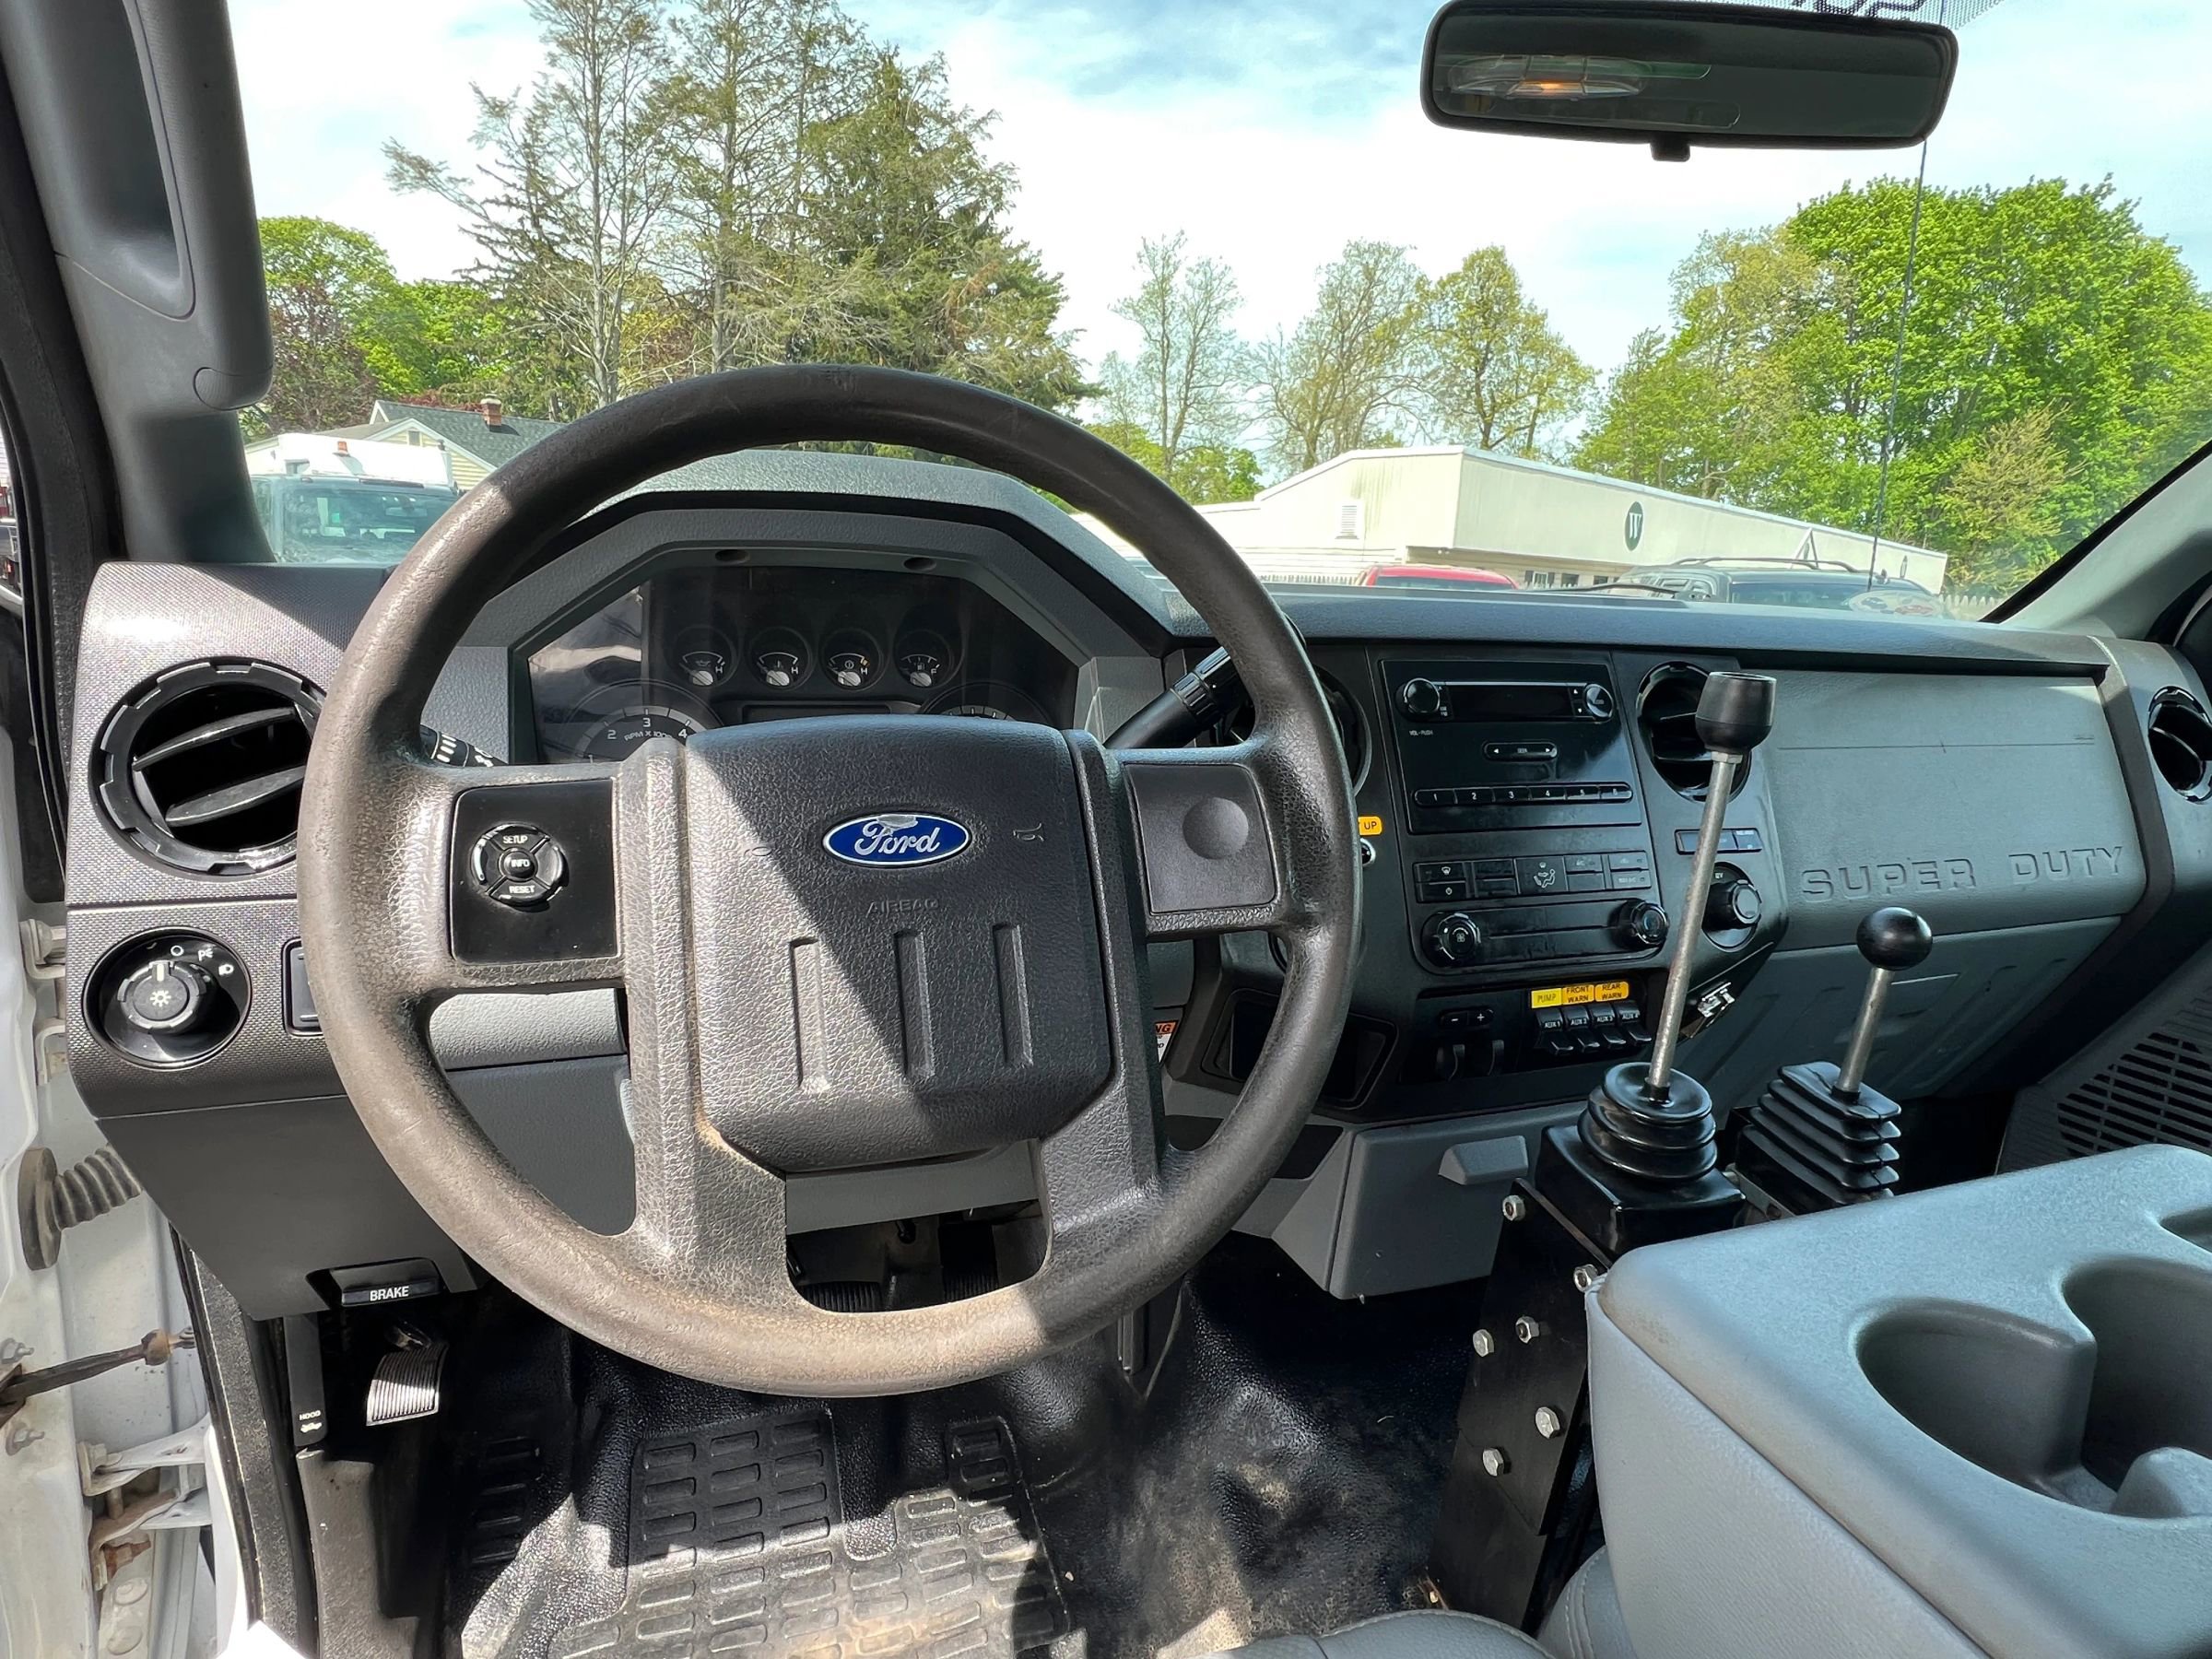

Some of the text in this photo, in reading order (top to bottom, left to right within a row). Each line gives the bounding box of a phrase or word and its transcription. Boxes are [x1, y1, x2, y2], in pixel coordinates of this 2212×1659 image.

[1629, 512, 1642, 539] W
[791, 666, 798, 675] H
[642, 717, 651, 727] 3
[607, 729, 617, 739] 2
[624, 731, 643, 741] RPM
[678, 728, 688, 738] 4
[1364, 820, 1378, 830] UP
[502, 834, 528, 844] SETUP
[853, 819, 941, 856] Ford
[511, 858, 531, 868] INFO
[1801, 845, 2124, 903] SUPER DUTY
[509, 885, 535, 894] RESET
[1567, 986, 1589, 994] FRONT
[1536, 993, 1557, 1004] PUMP
[370, 1286, 409, 1301] BRAKE
[299, 1409, 321, 1421] HOOD
